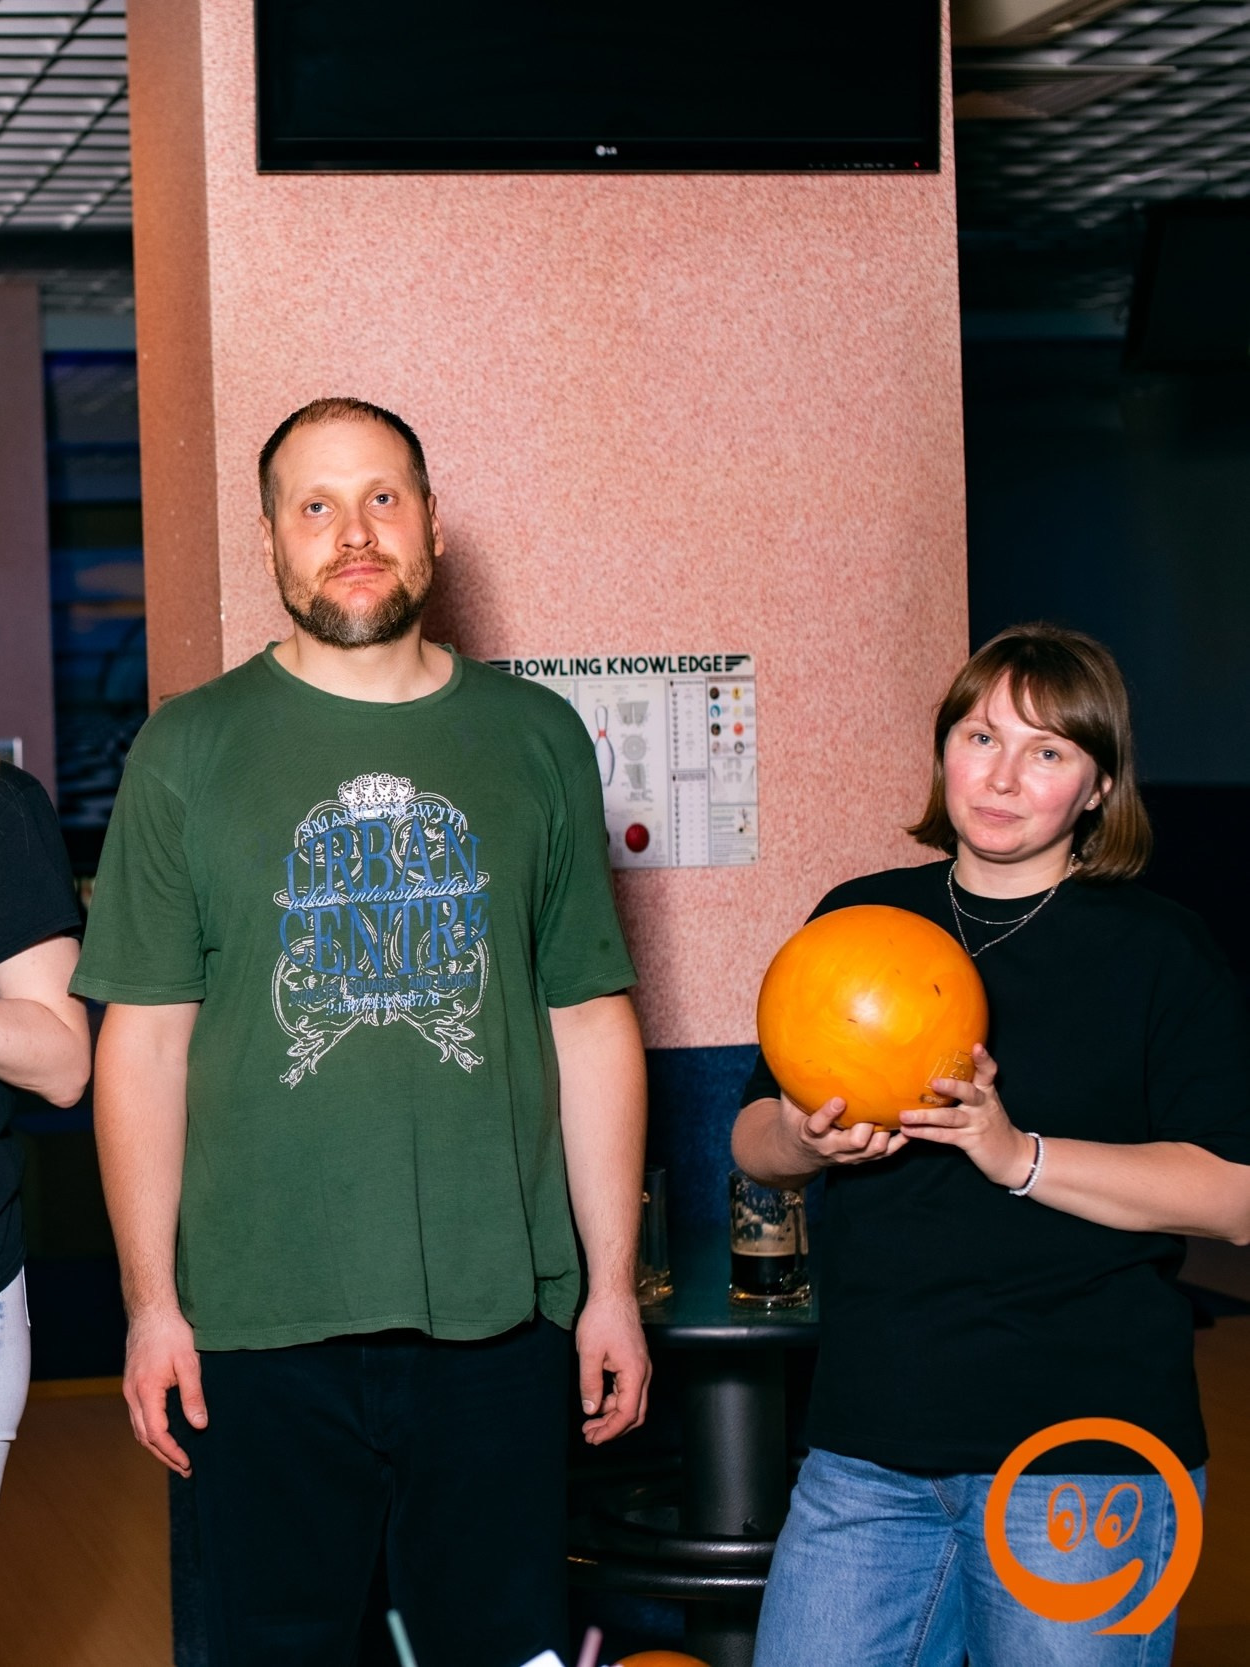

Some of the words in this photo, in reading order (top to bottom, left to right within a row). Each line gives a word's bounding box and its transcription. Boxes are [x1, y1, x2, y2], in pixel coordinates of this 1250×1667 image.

[513, 658, 602, 677] BOWLING
[607, 655, 723, 675] KNOWLEDGE
[283, 817, 481, 901] URBAN
[279, 893, 489, 979] CENTRE
[409, 975, 432, 989] AND
